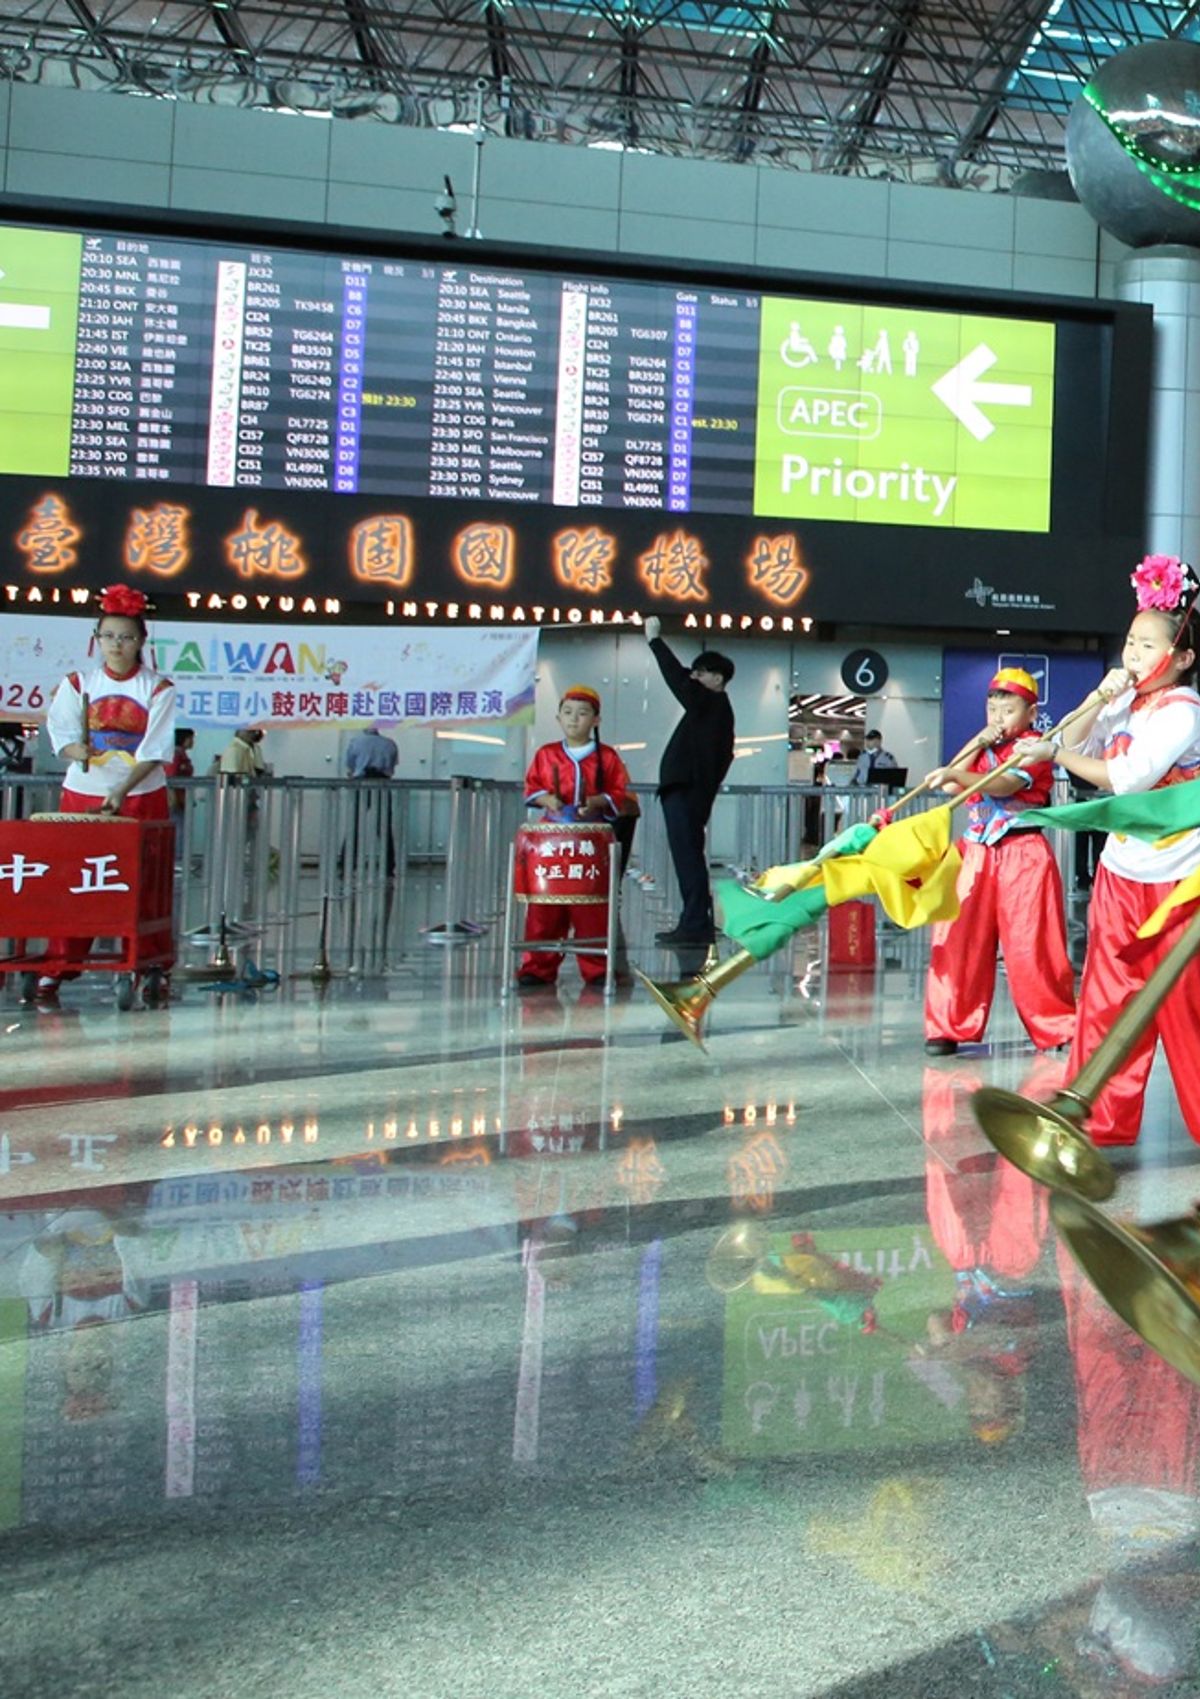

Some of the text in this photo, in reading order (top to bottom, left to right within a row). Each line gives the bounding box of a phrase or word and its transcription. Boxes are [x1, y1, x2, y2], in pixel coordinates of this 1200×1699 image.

[82, 253, 112, 264] 20:10
[117, 256, 137, 267] SEA
[81, 268, 111, 279] 20:30
[116, 271, 141, 281] MNL
[470, 273, 524, 287] Destination
[80, 283, 111, 294] 20:45
[470, 286, 489, 298] SEA
[498, 290, 530, 301] Seattle
[562, 281, 588, 294] Flight
[676, 292, 698, 302] Gate
[710, 295, 738, 307] Status
[79, 298, 110, 309] 21:10
[113, 300, 138, 311] ONT
[469, 301, 492, 311] MNL
[498, 303, 529, 315] Manila
[79, 313, 109, 325] 21:20
[113, 316, 132, 326] IAH
[497, 317, 537, 331] Bangkok
[78, 328, 108, 340] 21:45
[112, 330, 128, 341] IST
[468, 329, 490, 340] ONT
[496, 332, 532, 344] Ontario
[77, 343, 107, 355] 22:40
[111, 345, 127, 355] VIE
[495, 347, 535, 358] Houston
[76, 358, 106, 370] 23:00
[110, 361, 131, 372] SEA
[466, 358, 481, 368] IST
[494, 360, 532, 372] Istanbul
[494, 375, 526, 385] Vienna
[74, 389, 105, 400] 23:30
[108, 390, 133, 402] CDG
[75, 374, 106, 385] 23:25
[109, 375, 131, 386] YVR
[386, 395, 416, 407] 23:30
[465, 386, 484, 397] SEA
[493, 389, 526, 400] Seattle
[74, 404, 104, 415] 23:30
[108, 405, 129, 417] SFO
[464, 401, 484, 410] YVR
[492, 403, 542, 416] Vancouver
[788, 397, 869, 429] APEC
[73, 419, 103, 430] 23:30
[107, 421, 129, 431] MEL
[463, 415, 486, 426] CDG
[492, 417, 514, 428] Paris
[72, 434, 102, 446] 23:30
[106, 435, 127, 447] SEA
[463, 429, 483, 440] SFO
[71, 449, 101, 461] 23:30
[105, 450, 127, 461] SYD
[462, 443, 483, 454] MEL
[491, 446, 542, 458] Melbourne
[70, 464, 100, 476] 23:35
[104, 465, 126, 476] YVR
[462, 458, 480, 468] SEA
[490, 460, 522, 471] Seattle
[461, 472, 481, 483] SYD
[489, 473, 524, 487] Sydney
[780, 453, 958, 516] Priority
[460, 486, 480, 496] YVR
[489, 489, 538, 501] Vancouver
[17, 493, 809, 604] 臺灣桃園國際機場
[5, 585, 813, 632] TAIW TAOYUAN INTERNATIONAL AIRPORT
[152, 636, 326, 674] TAIWAN
[855, 658, 874, 687] 6
[0, 684, 44, 708] 26
[0, 854, 130, 894] 中正
